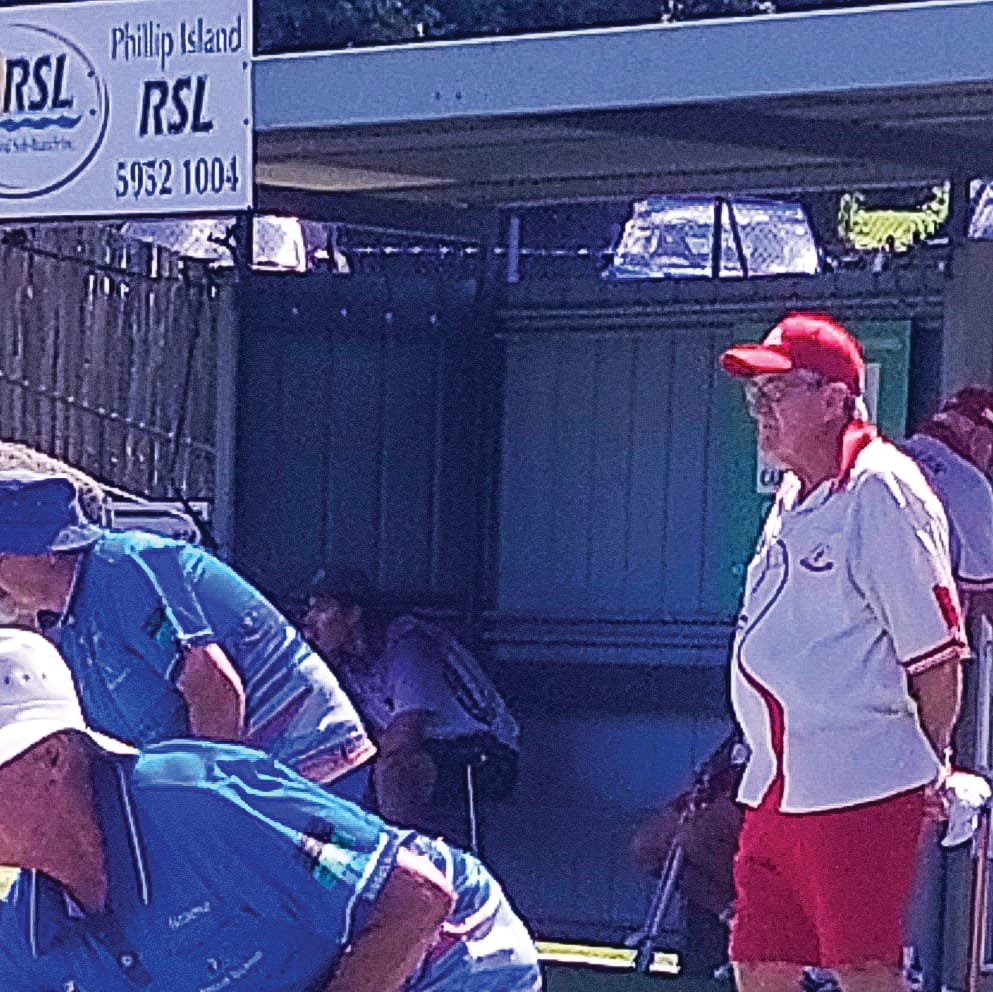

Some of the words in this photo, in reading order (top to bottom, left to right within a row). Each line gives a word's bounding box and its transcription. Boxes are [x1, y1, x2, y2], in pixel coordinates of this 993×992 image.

[111, 19, 174, 70] Phillip
[180, 15, 242, 54] Island
[3, 53, 74, 113] RSL
[139, 73, 214, 137] RSL
[115, 157, 173, 198] 5952
[181, 155, 239, 195] 1004
